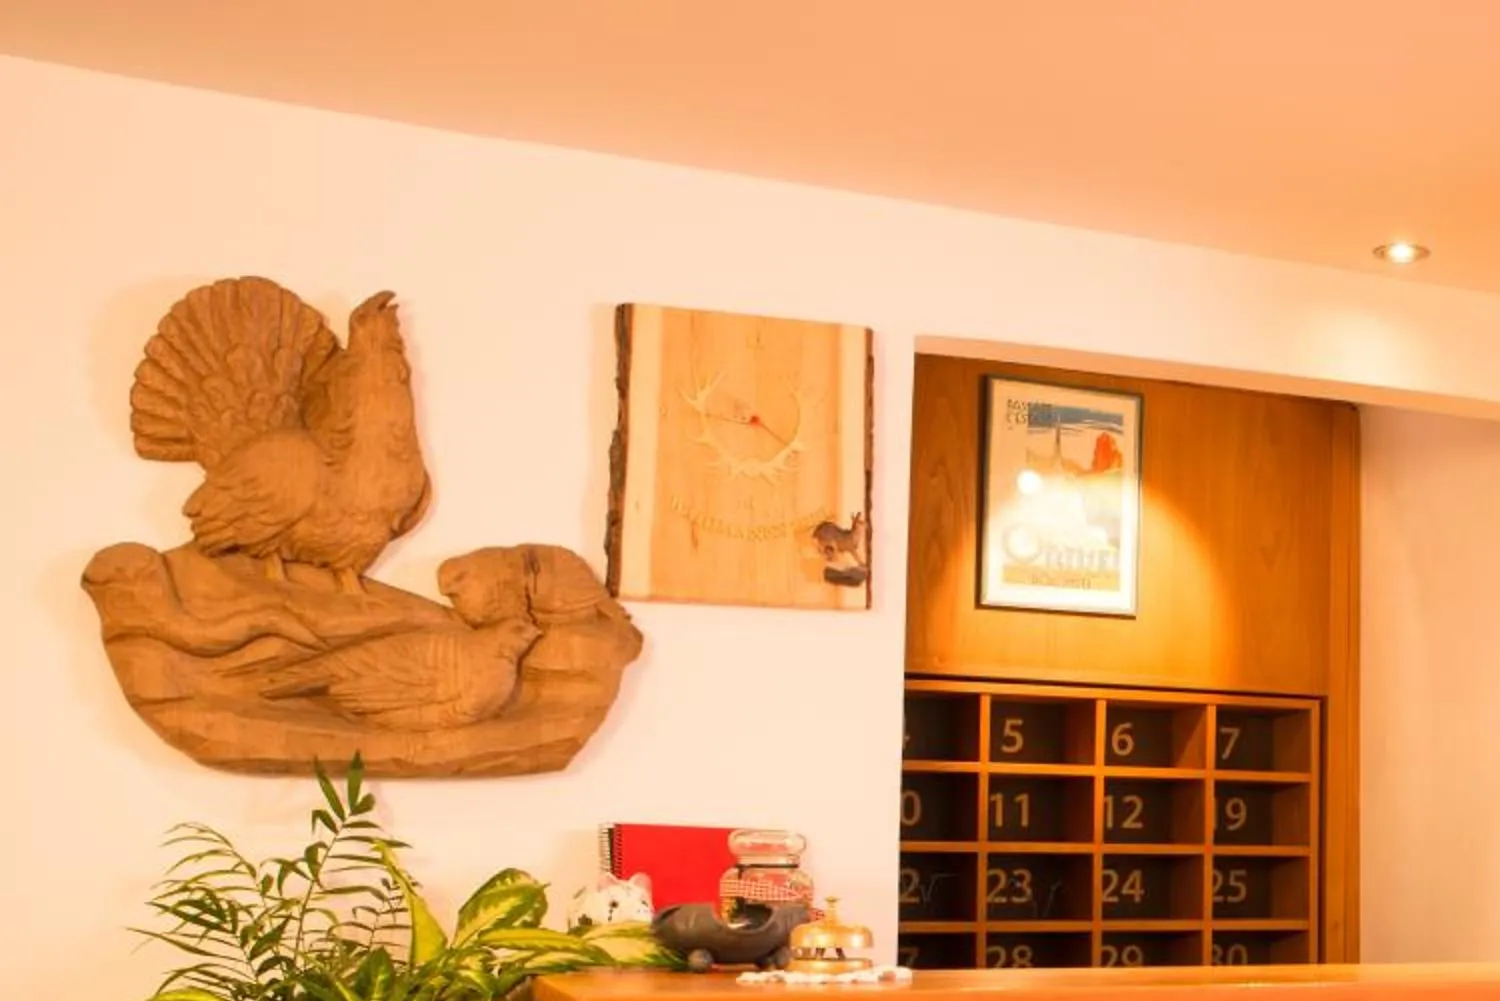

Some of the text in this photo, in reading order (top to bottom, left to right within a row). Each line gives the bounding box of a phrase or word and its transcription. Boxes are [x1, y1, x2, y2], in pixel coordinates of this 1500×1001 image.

[1002, 719, 1024, 753] 5
[1111, 722, 1134, 755] 6
[1219, 727, 1240, 760] 7
[900, 790, 921, 826] 0
[990, 793, 1030, 828] 11
[1104, 795, 1144, 829] 12
[986, 868, 1032, 903] 23
[1102, 869, 1145, 903] 24
[1213, 869, 1247, 903] 25
[987, 945, 1033, 968] 28
